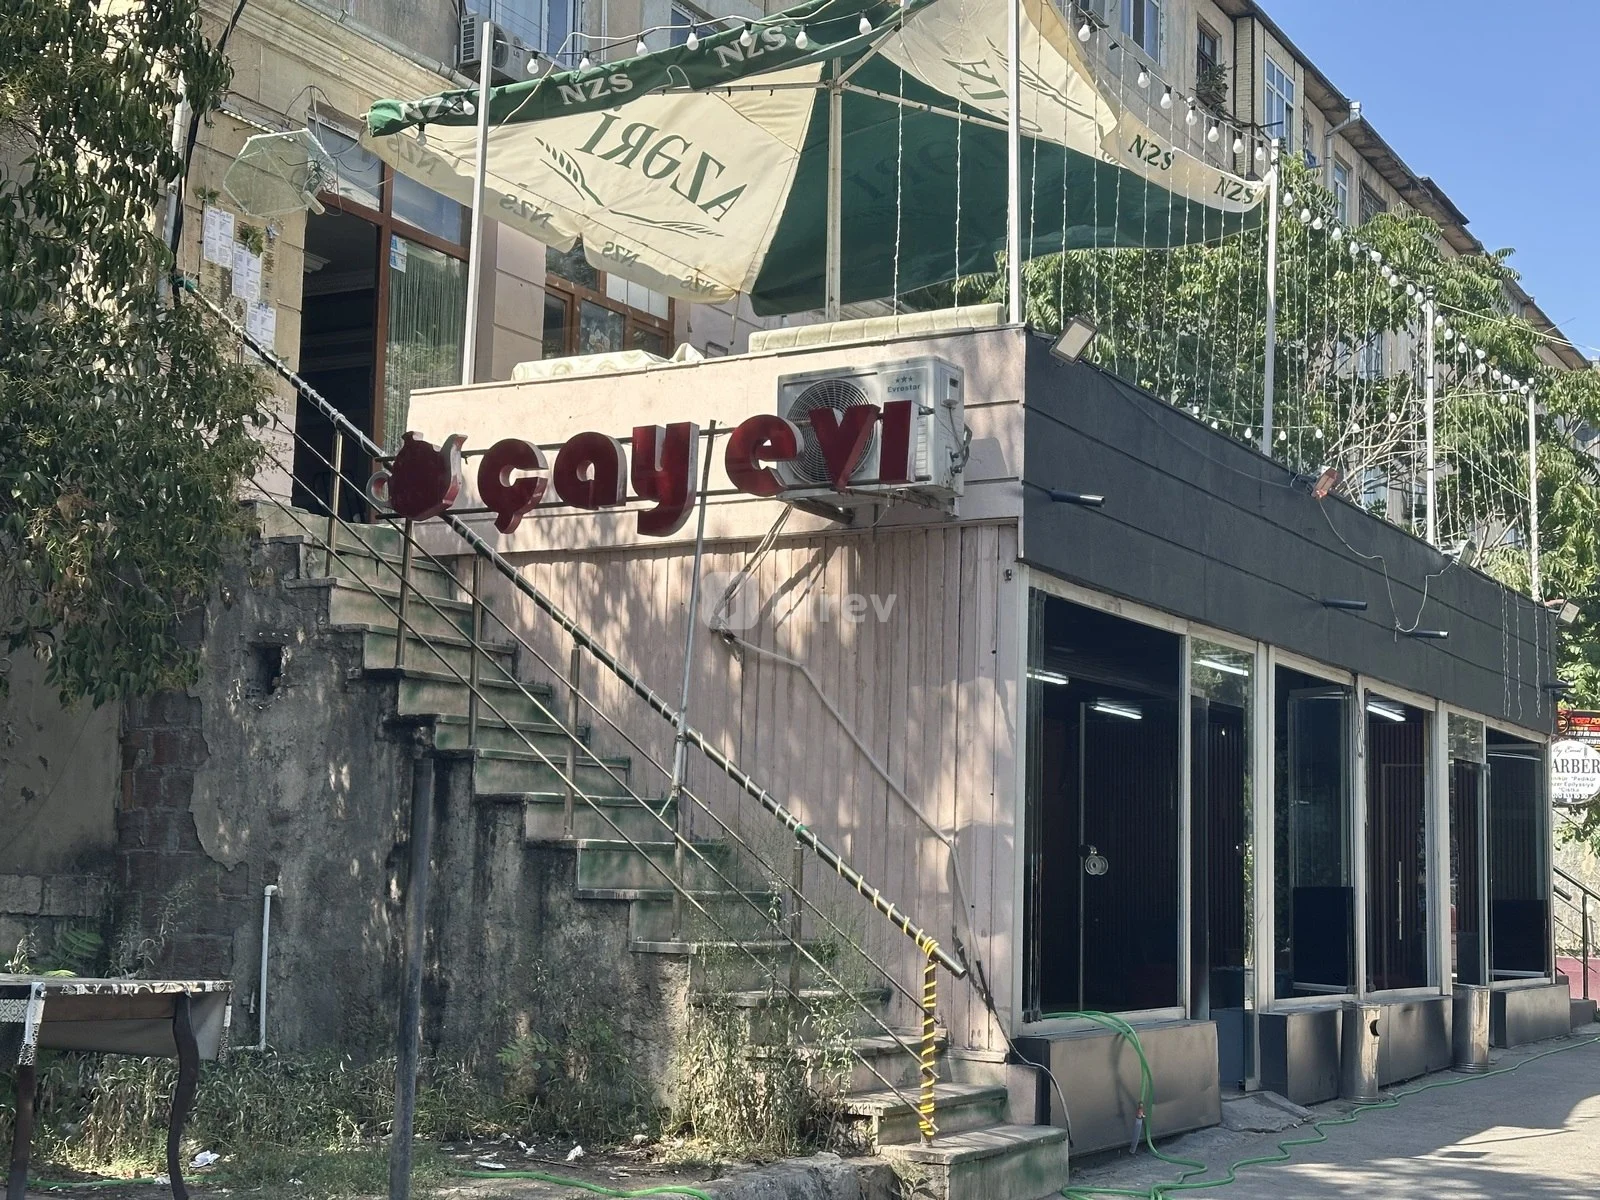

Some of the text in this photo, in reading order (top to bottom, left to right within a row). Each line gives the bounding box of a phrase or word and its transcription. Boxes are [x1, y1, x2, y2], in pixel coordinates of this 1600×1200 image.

[712, 26, 787, 68] NZS
[557, 73, 634, 105] NZS
[1127, 134, 1175, 170] NZS
[1213, 176, 1258, 204] NZS
[887, 384, 920, 393] Evrostar
[476, 421, 699, 538] çay
[1551, 758, 1600, 774] ARBER
